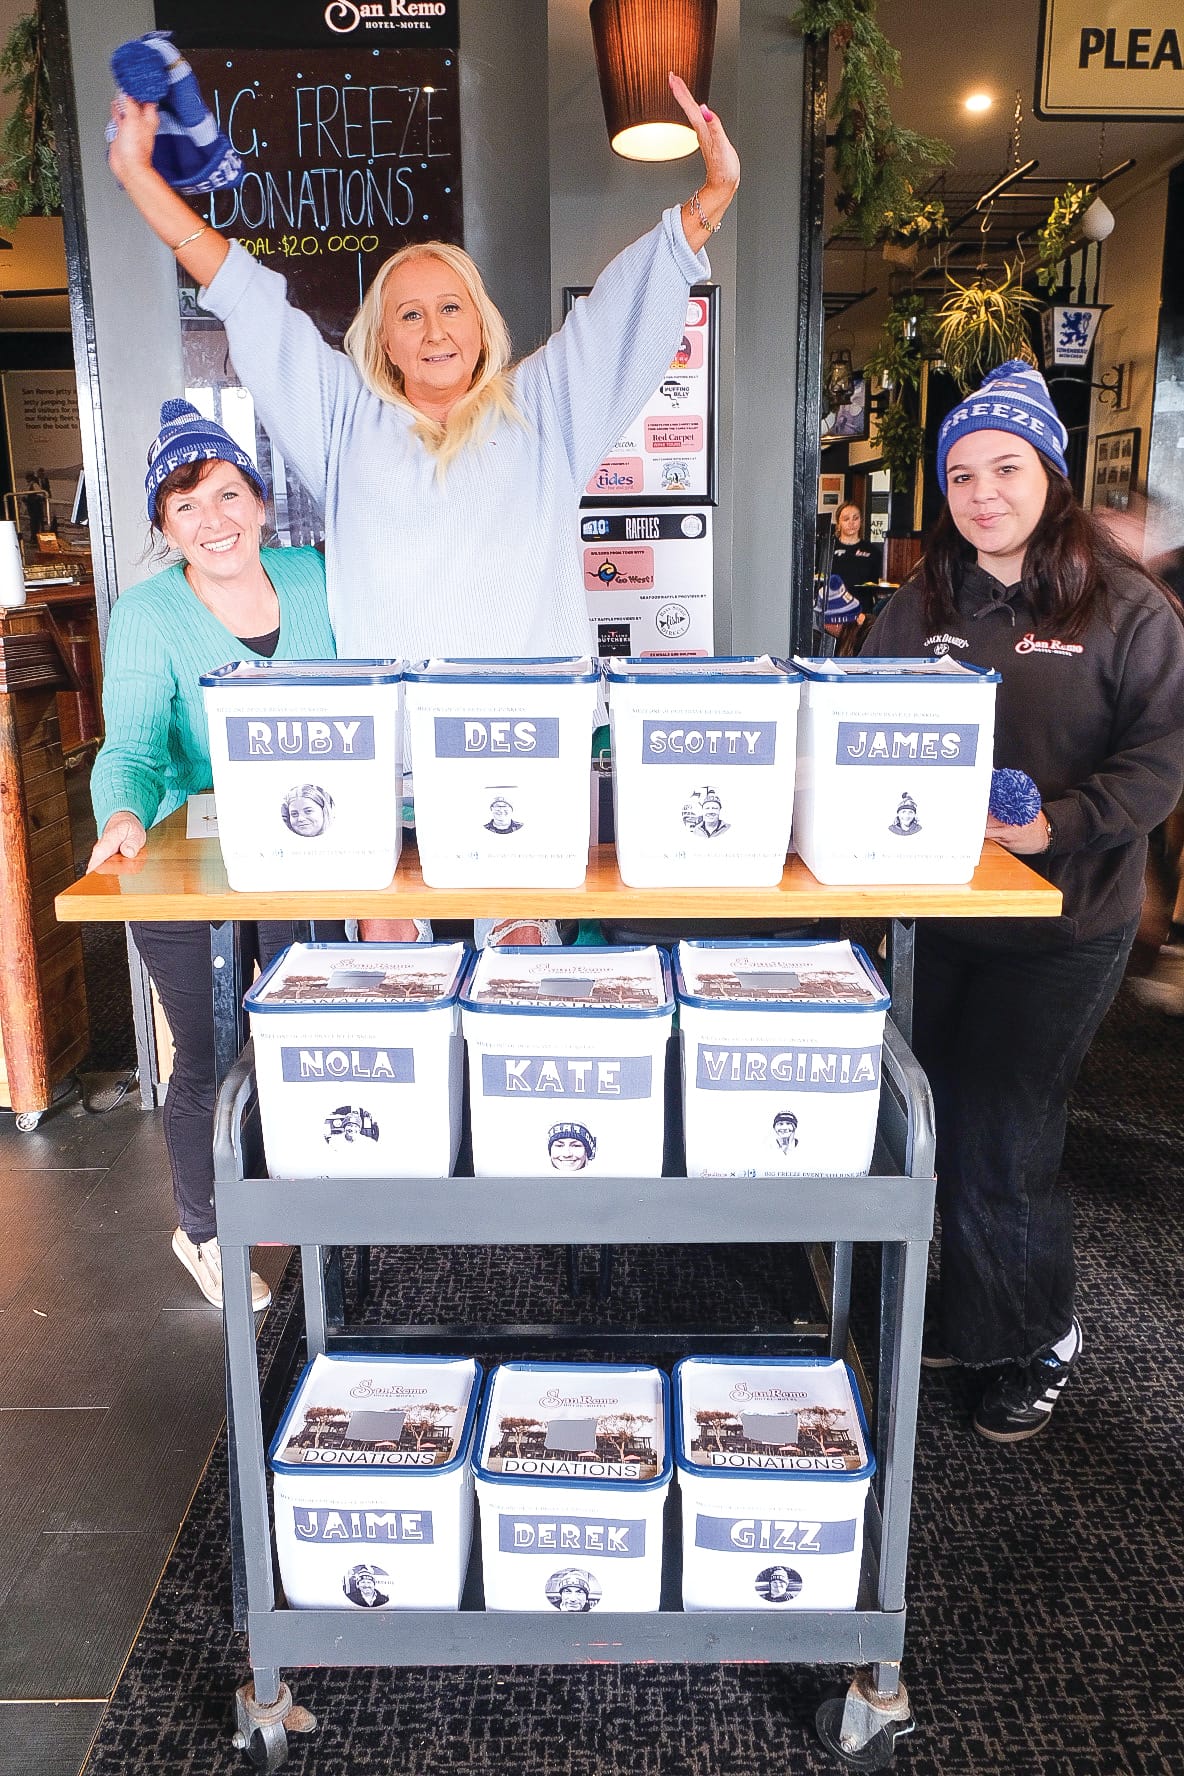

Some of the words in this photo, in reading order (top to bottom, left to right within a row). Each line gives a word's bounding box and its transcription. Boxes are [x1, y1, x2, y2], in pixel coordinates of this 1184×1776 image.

[325, 0, 385, 32] San
[389, 0, 446, 16] Remo
[1078, 28, 1184, 70] PLEA
[214, 87, 259, 157] IG
[296, 85, 451, 158] FREEZE
[210, 168, 413, 230] DONATIONS
[669, 434, 694, 443] Carpet
[598, 473, 634, 486] tides
[625, 517, 660, 539] RAFFLES
[615, 575, 628, 584] Go
[247, 721, 361, 755] RUBY
[464, 721, 536, 752] DES
[649, 730, 762, 754] SCOTTY
[847, 731, 961, 759] JAMES
[299, 1050, 395, 1078] NOLA
[505, 1059, 621, 1094] KATE
[703, 1051, 876, 1083] VIRGINIA
[303, 1450, 434, 1465] DONATIONS
[503, 1460, 638, 1478] DONATIONS
[711, 1453, 845, 1470] DONATIONS
[297, 1511, 423, 1540] JAIME
[513, 1522, 629, 1552] DEREK
[730, 1520, 822, 1552] GIZZ
